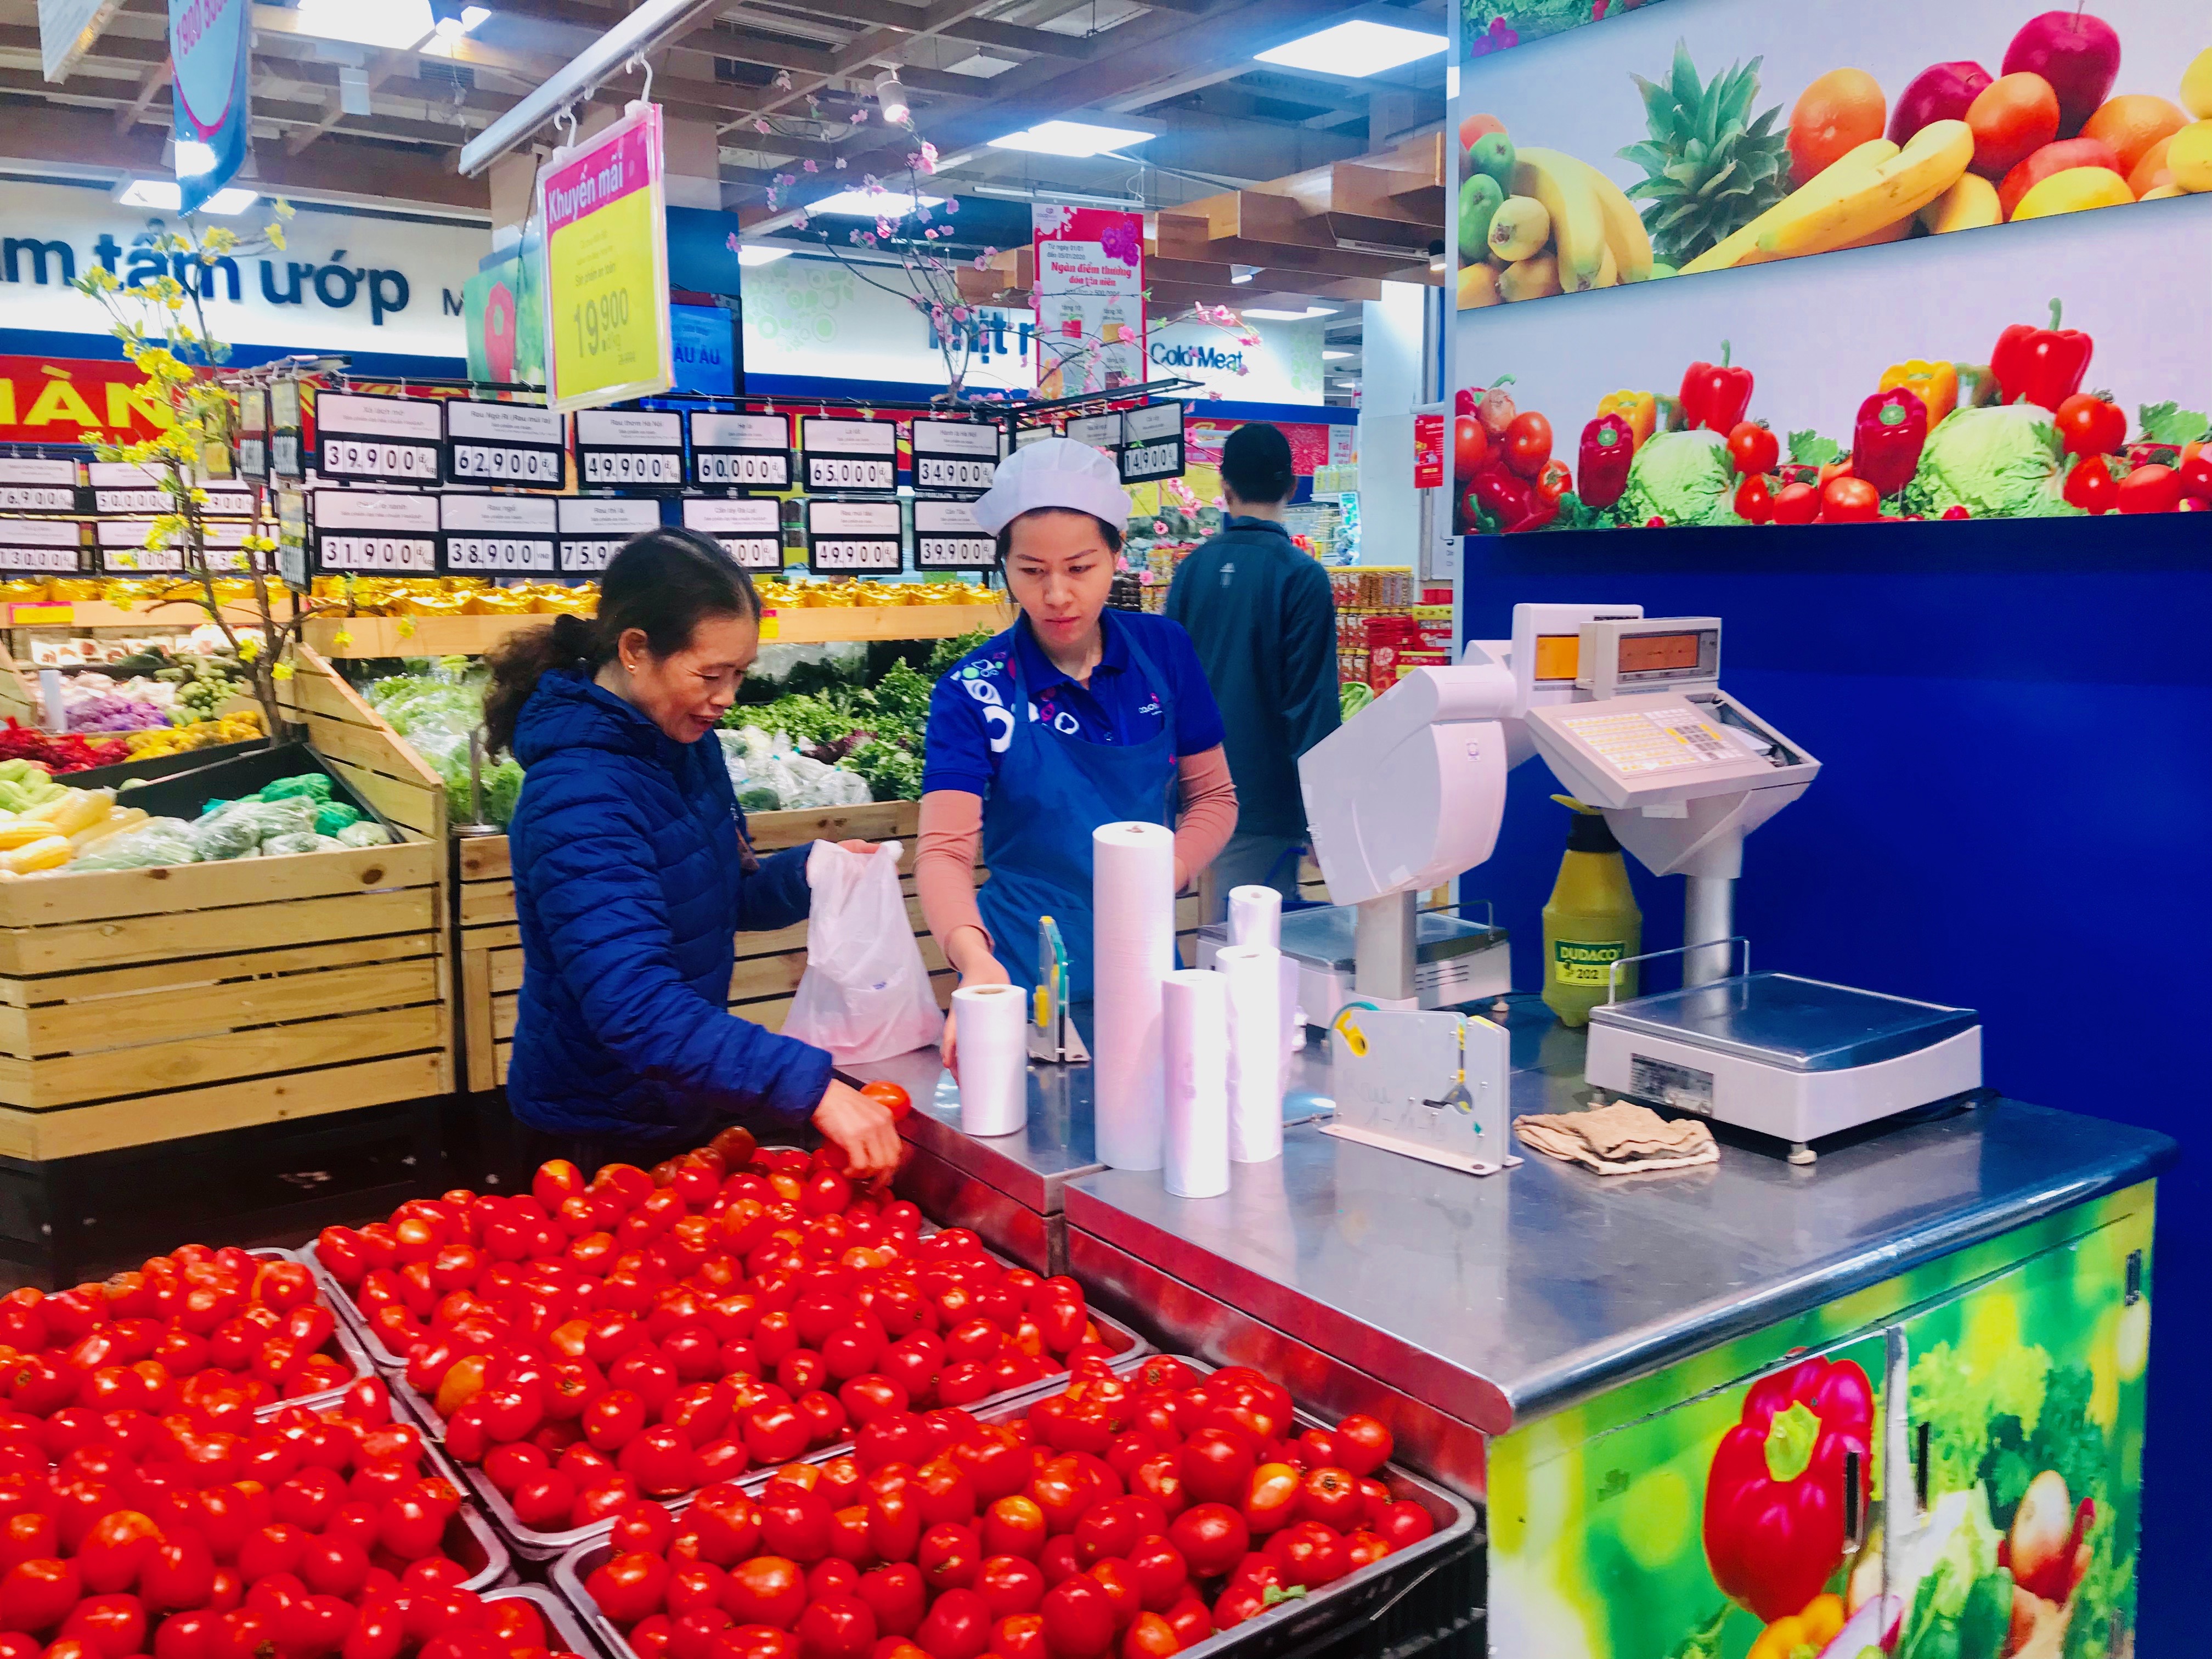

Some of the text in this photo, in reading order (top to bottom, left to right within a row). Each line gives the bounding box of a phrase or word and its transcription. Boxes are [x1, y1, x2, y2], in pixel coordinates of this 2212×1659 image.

[0, 238, 75, 286] m
[258, 250, 410, 326] ướp
[1150, 342, 1243, 369] Cold Meat
[329, 445, 414, 471] 39.900
[459, 449, 538, 474] 62.900
[588, 457, 661, 477] 49.900
[702, 458, 769, 478] 60.000
[1126, 449, 1167, 472] 14.900
[814, 463, 876, 482] 65.000
[921, 462, 980, 483] 34.900
[326, 541, 411, 563] 31.900
[452, 543, 531, 564] 38.900
[820, 545, 882, 564] 49.900
[923, 543, 981, 561] 39.900
[1560, 946, 1620, 961] DUDACO
[1576, 968, 1598, 979] 202
